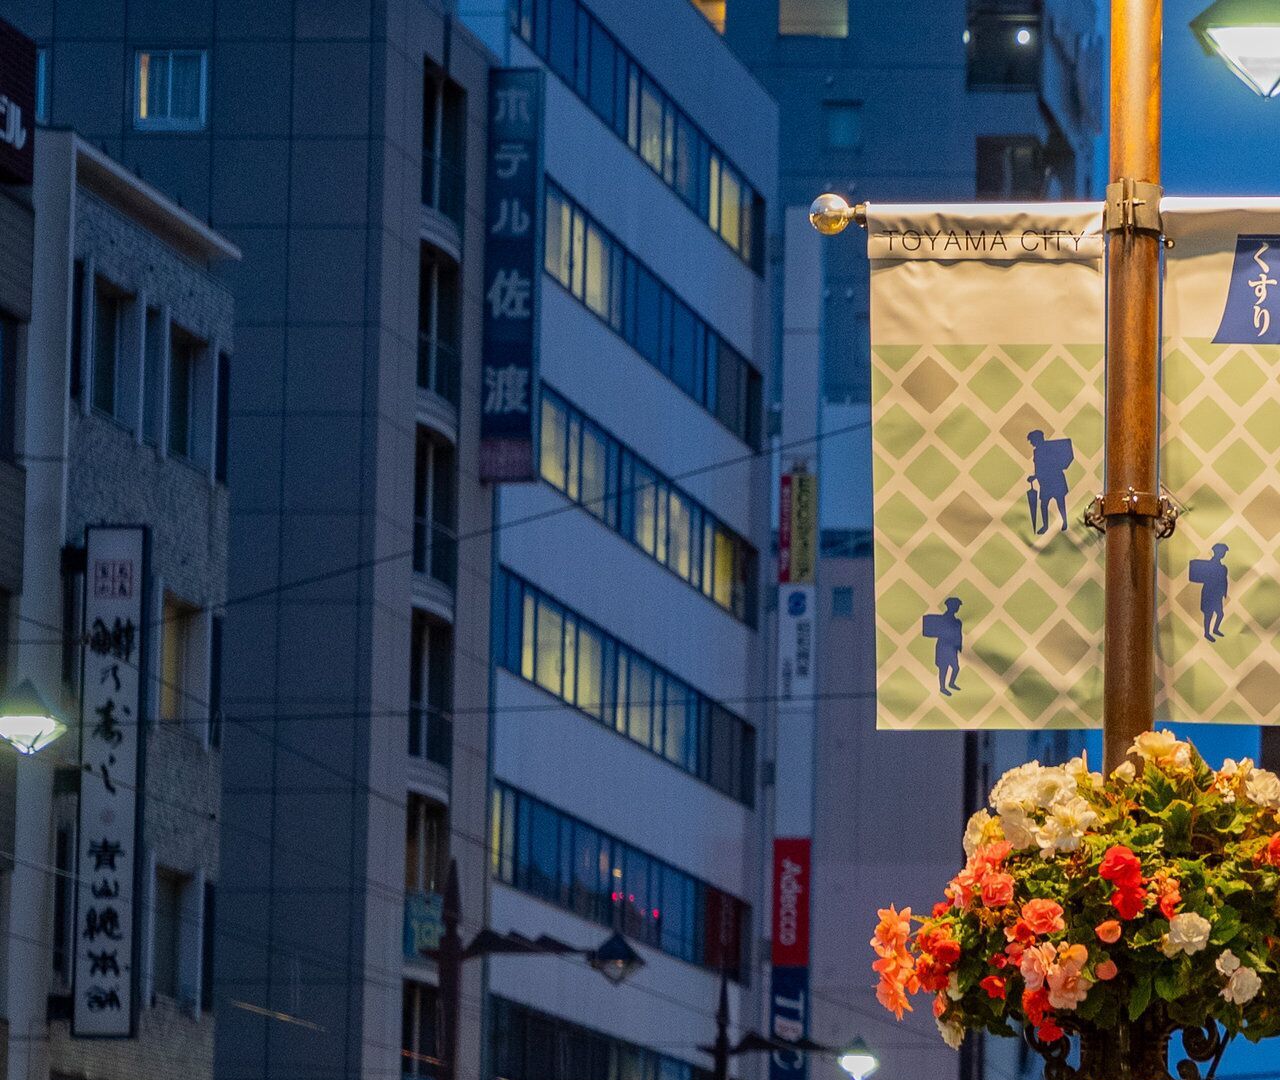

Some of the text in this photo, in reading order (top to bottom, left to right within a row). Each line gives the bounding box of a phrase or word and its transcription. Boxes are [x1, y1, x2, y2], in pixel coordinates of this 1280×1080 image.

[484, 87, 533, 414] ホテル佐渡
[883, 228, 1086, 253] TOYAMA CITY
[1247, 242, 1276, 337] くすり
[779, 856, 803, 945] Adecco
